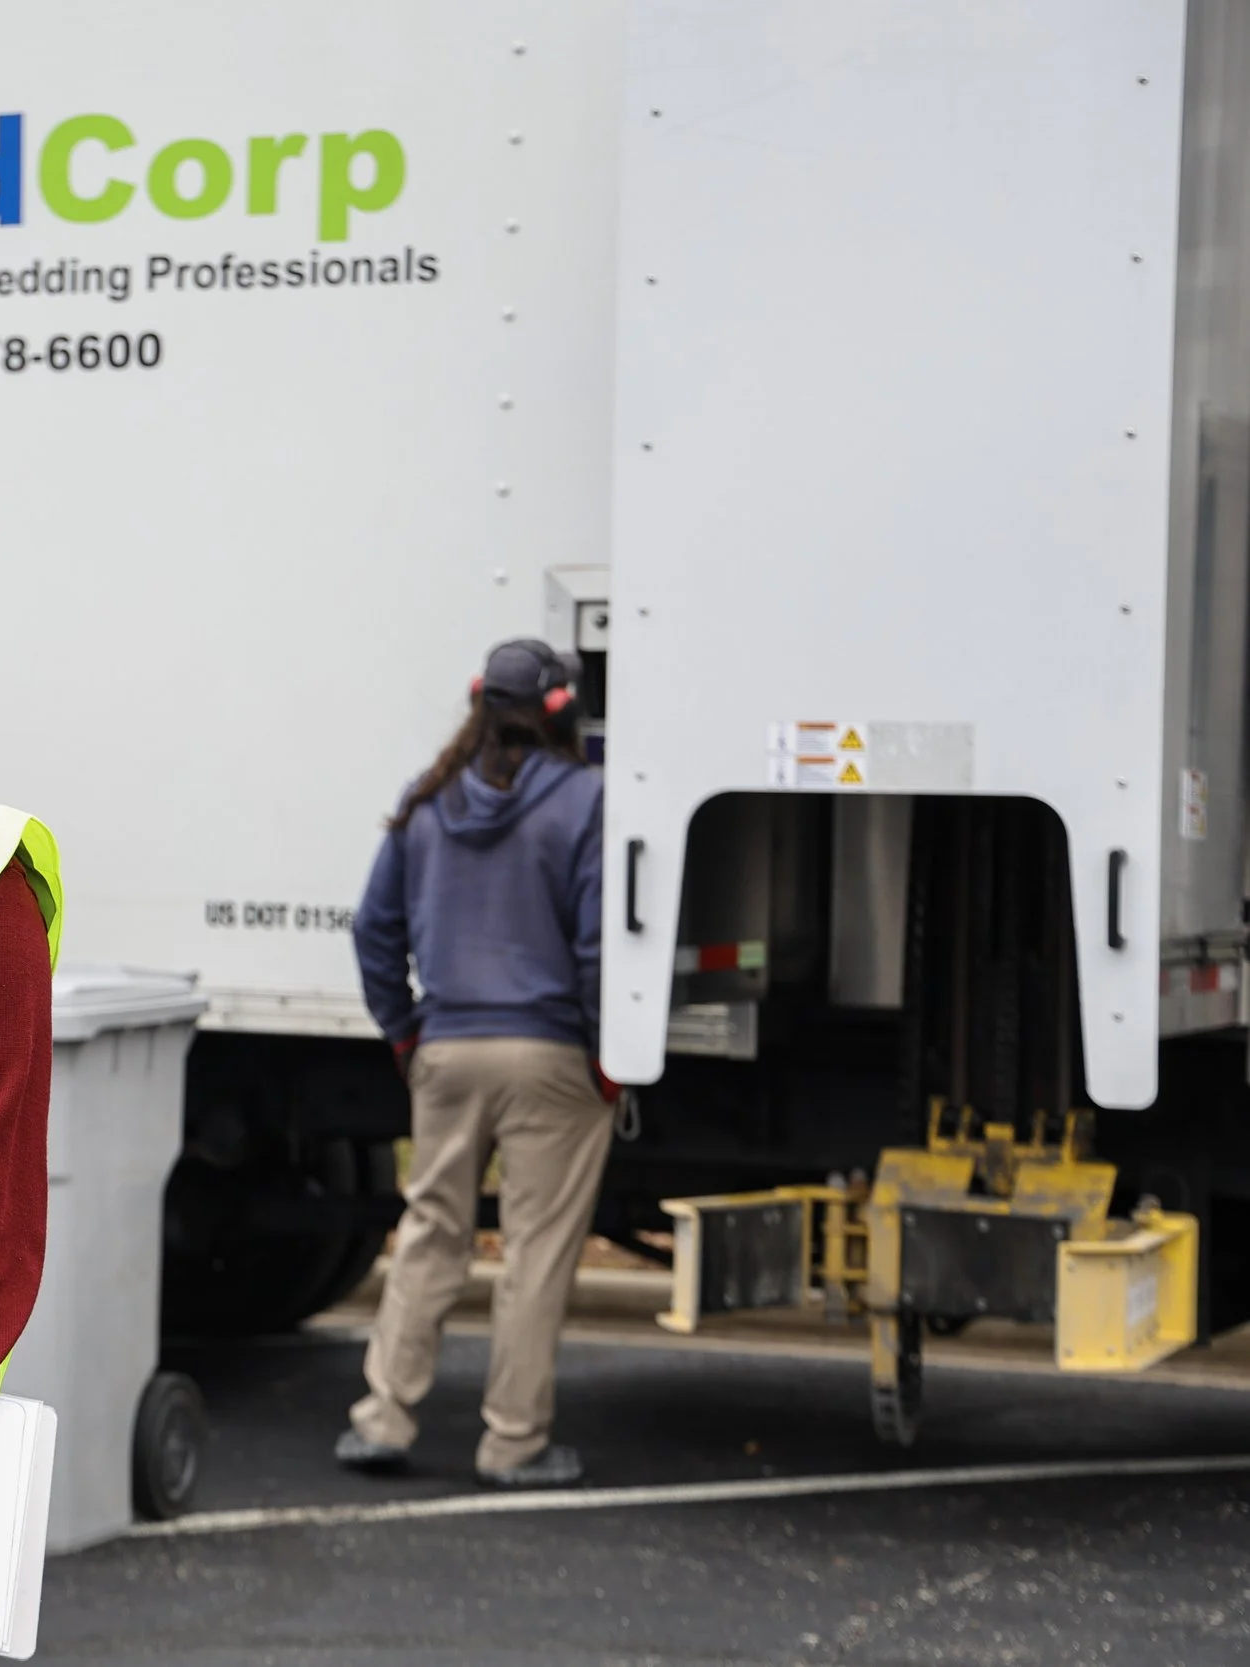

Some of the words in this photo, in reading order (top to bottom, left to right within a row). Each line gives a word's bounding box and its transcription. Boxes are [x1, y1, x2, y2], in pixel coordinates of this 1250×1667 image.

[147, 246, 440, 290] Professionals
[205, 901, 236, 928] US
[243, 902, 288, 929] DOT
